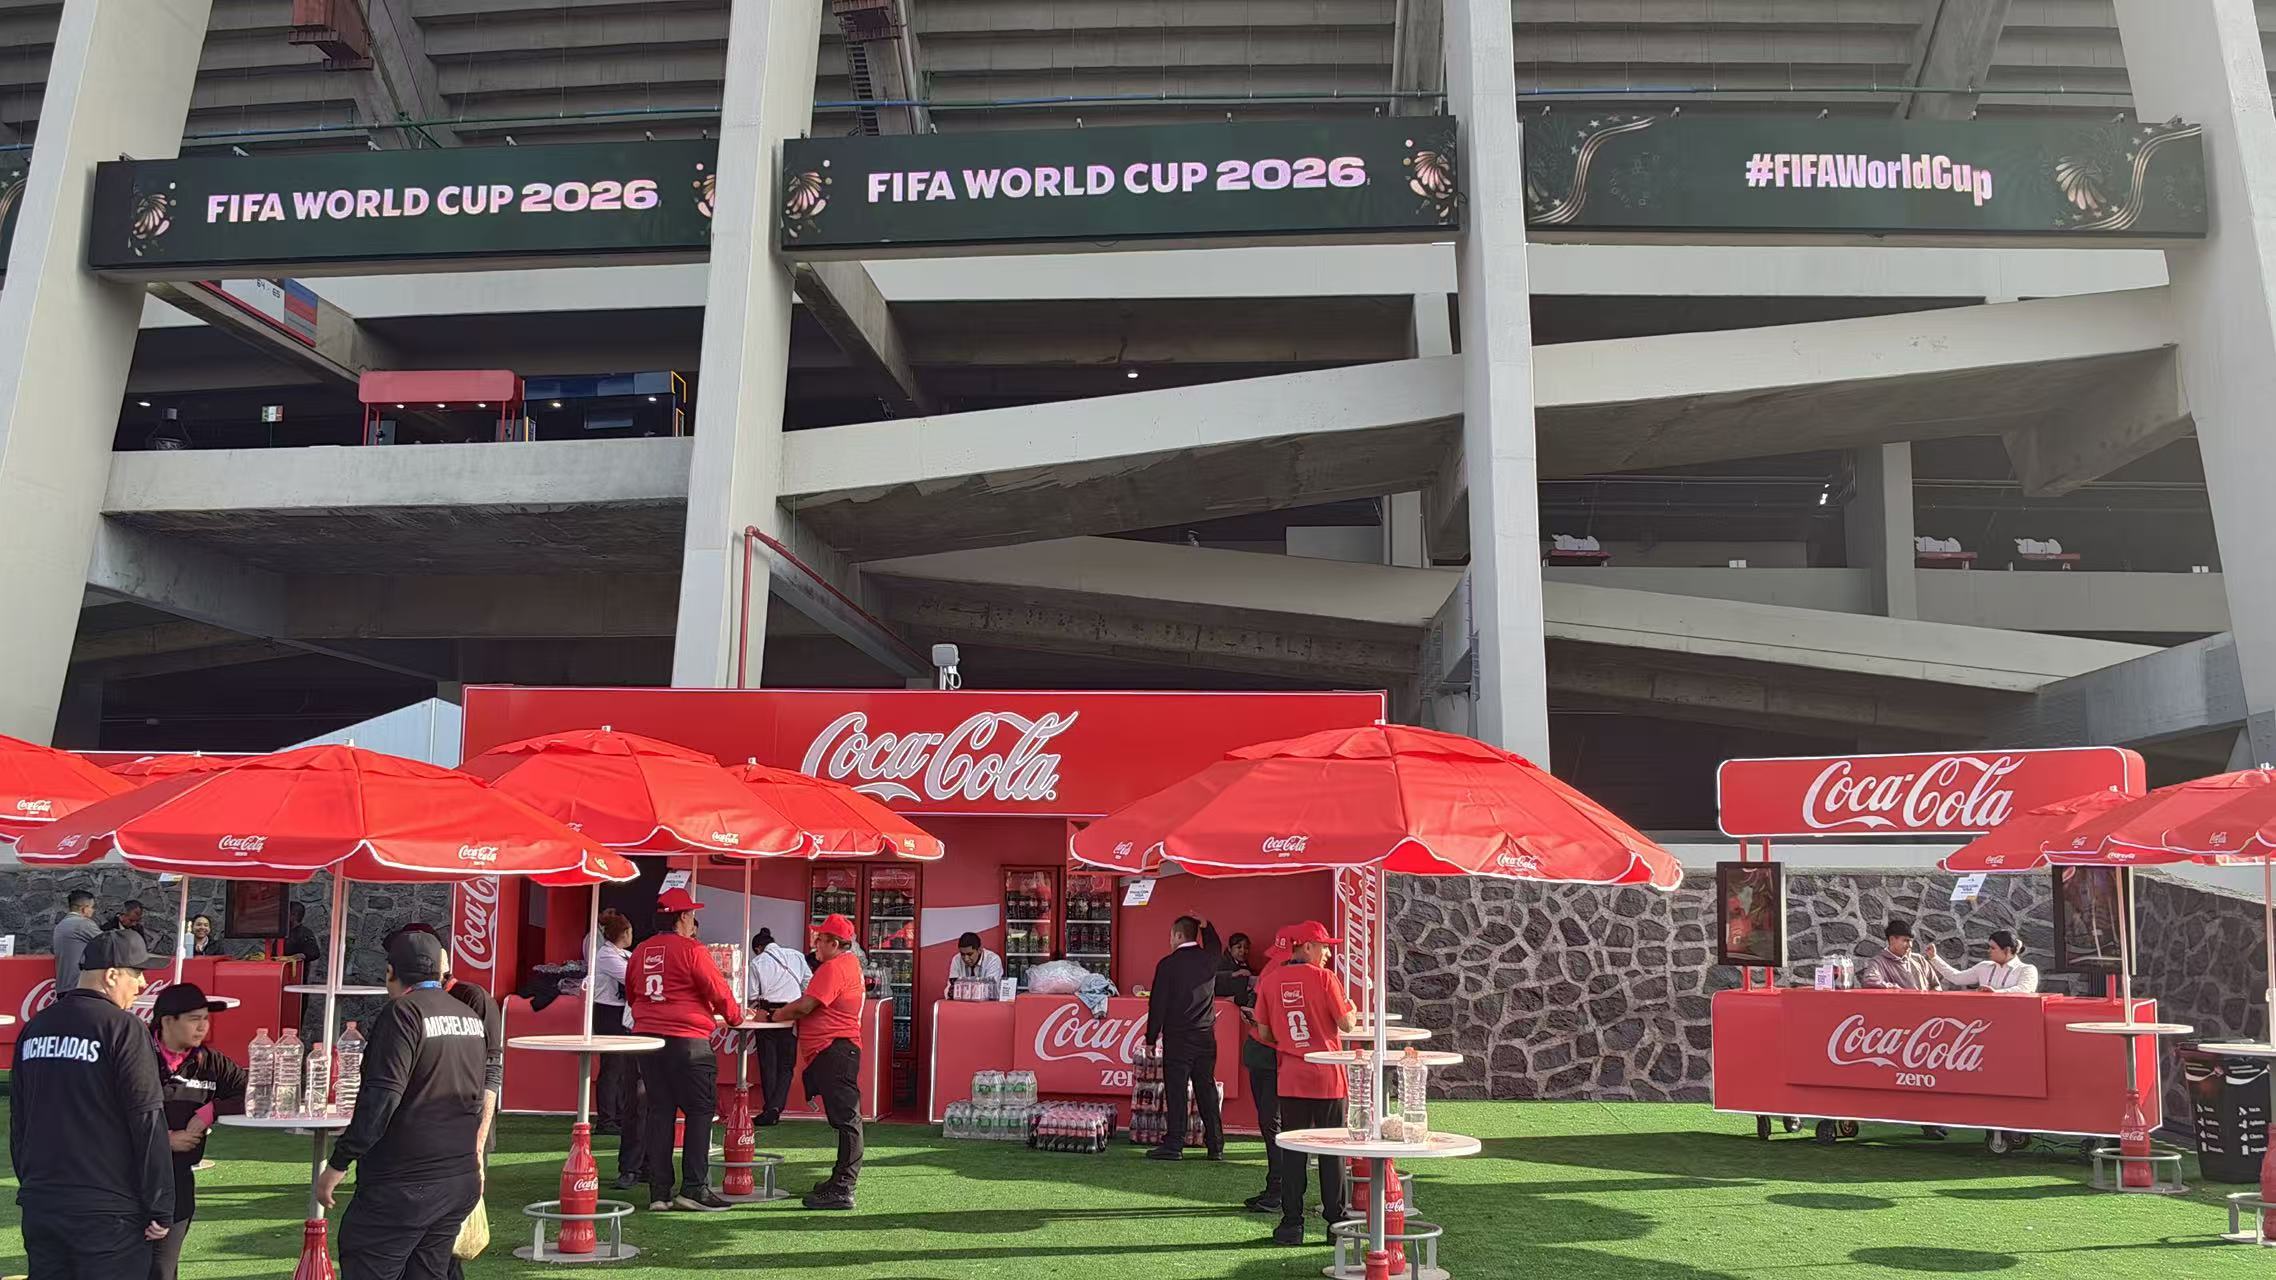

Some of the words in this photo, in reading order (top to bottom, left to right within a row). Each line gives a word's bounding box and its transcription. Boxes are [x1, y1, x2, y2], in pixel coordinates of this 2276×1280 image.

[207, 193, 285, 223] FIFA
[293, 187, 430, 220] WORLD
[437, 184, 514, 215] CUP
[520, 179, 659, 212] 2026
[867, 171, 956, 202] FIFA
[963, 164, 1115, 199] WORLD
[1123, 161, 1207, 194] CUP
[1215, 156, 1366, 191] 2026
[1745, 153, 1993, 207] #FIFAWorldCup
[801, 711, 1079, 801] Coca-Cola
[1802, 756, 2026, 829] Coca-Cola
[218, 834, 269, 853] Coca-Cola
[1262, 835, 1310, 853] Coca-Cola
[22, 1035, 101, 1063] MICHELADAS
[1827, 1014, 1993, 1072] Coca-Cola
[1101, 1069, 1134, 1087] zer
[1896, 1072, 1936, 1088] zero
